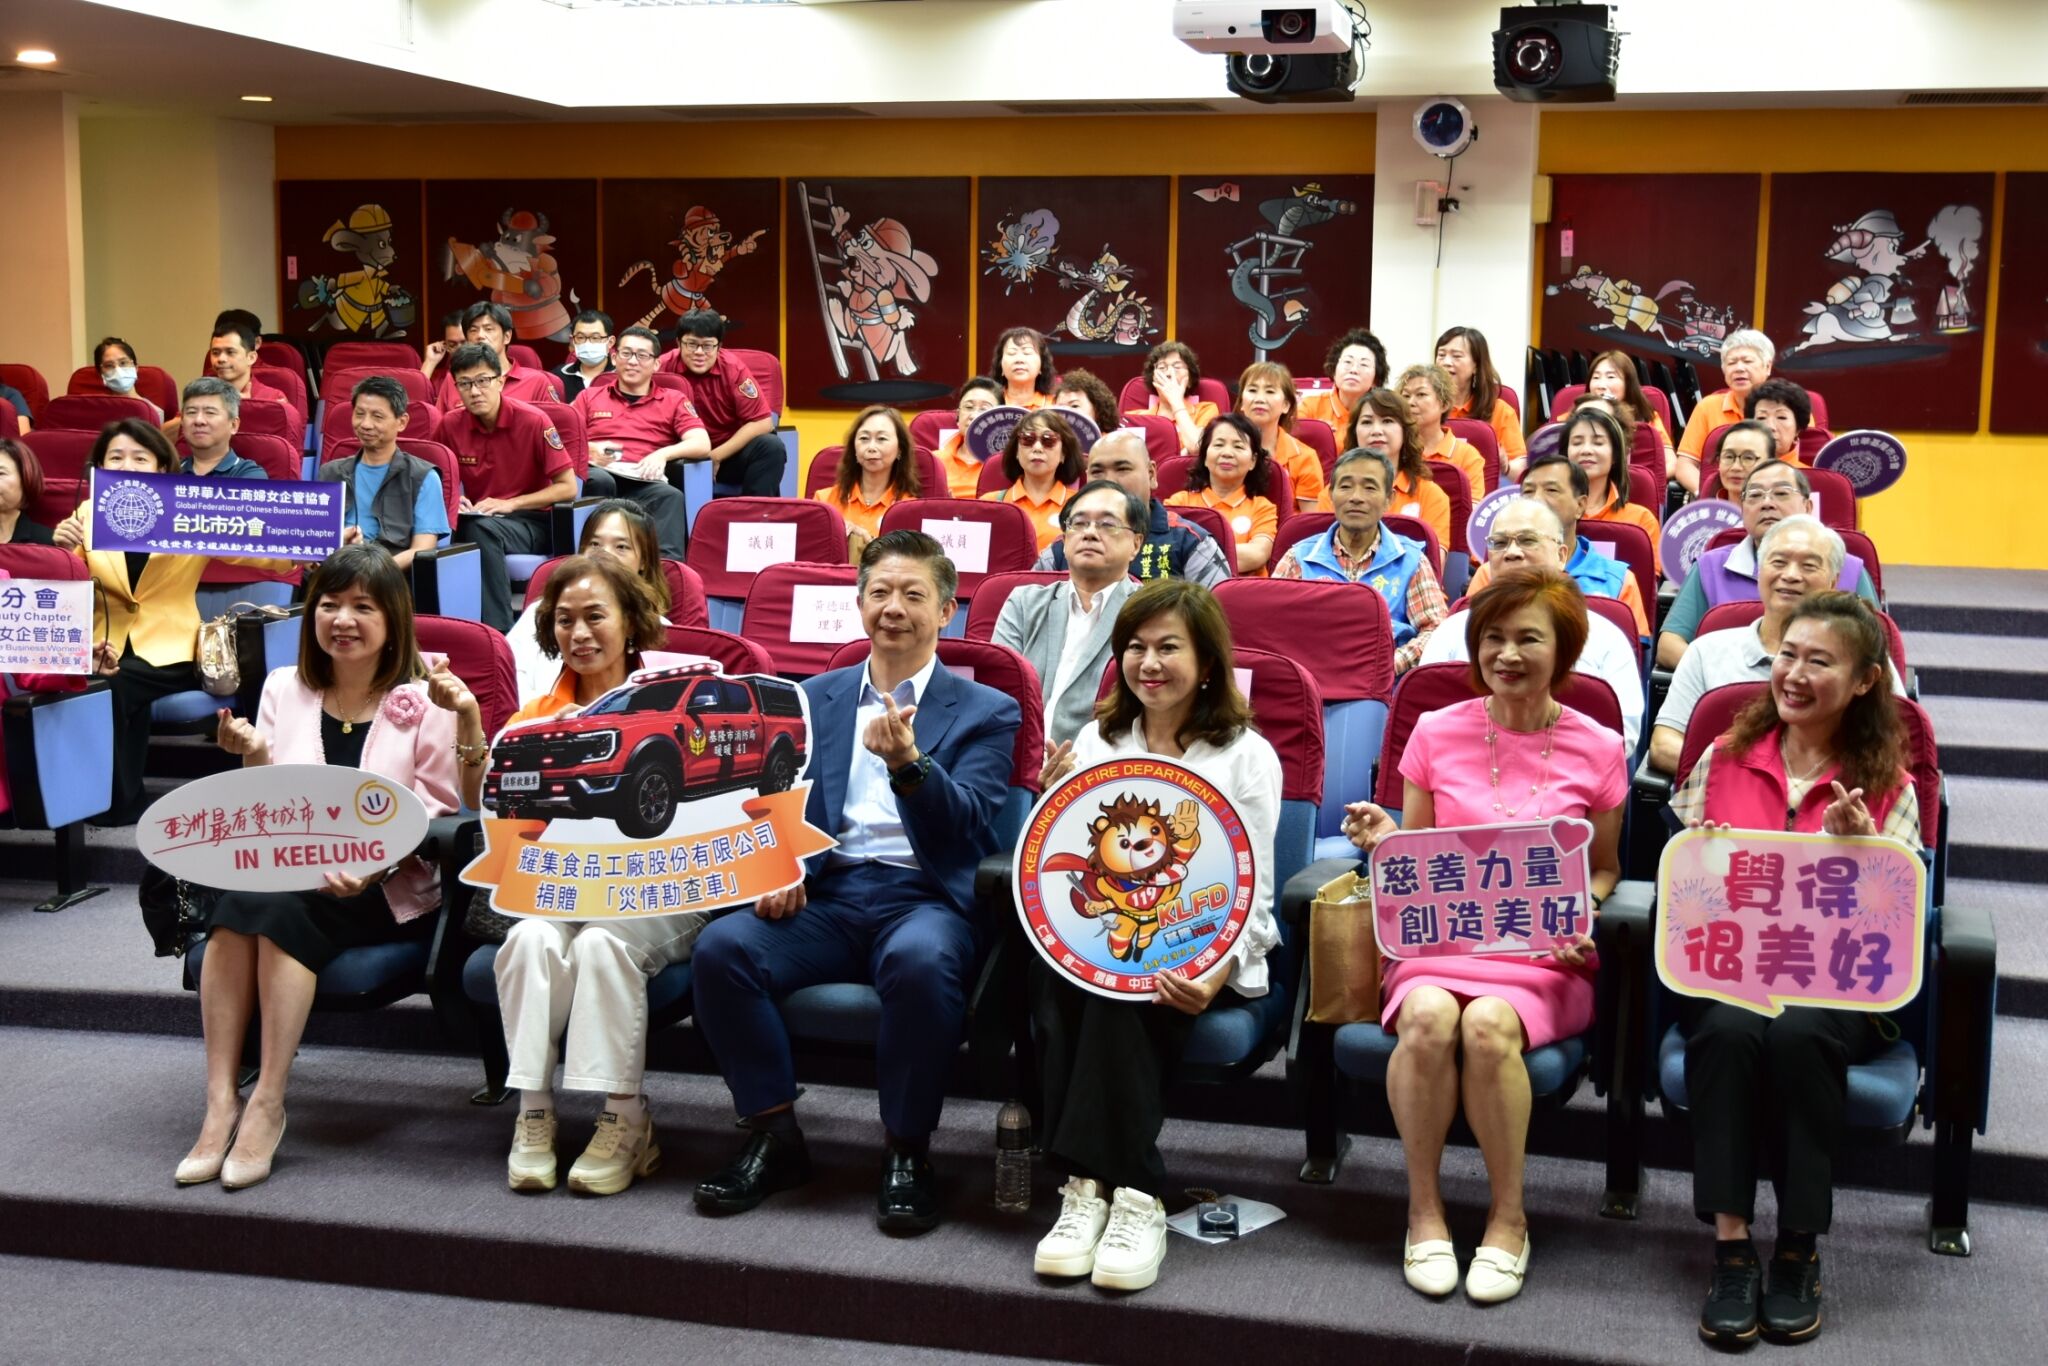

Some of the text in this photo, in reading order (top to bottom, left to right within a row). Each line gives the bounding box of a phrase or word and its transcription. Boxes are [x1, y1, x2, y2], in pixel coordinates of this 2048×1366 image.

[174, 484, 332, 506] 世界華人工商婦女企管協會
[175, 501, 330, 517] Global Federation of Chinese Business Women
[172, 512, 266, 537] 台北市分會
[266, 526, 336, 539] Taipei city chapter
[747, 536, 775, 551] 議員
[941, 533, 968, 549] 議員
[1, 587, 60, 609] 分會
[24, 611, 72, 623] Chapter
[818, 619, 843, 632] 理事
[0, 625, 82, 643] 女企管協會
[6, 643, 82, 653] Business Women
[709, 729, 756, 743] 基隆市消防局
[714, 743, 747, 757] 暖暖 41
[1025, 764, 1218, 873] KEELUNG CITY FIRE DEPARTMENT
[1219, 807, 1242, 837] 119
[235, 840, 386, 870] IN KEELUNG
[518, 822, 778, 880] 耀集食品工廠股份有限公司
[1379, 846, 1564, 895] 慈善力量
[536, 870, 740, 913] 捐贈 「災情勘查車」
[1723, 849, 1860, 917] 覺得
[1024, 881, 1038, 912] 119
[1130, 886, 1157, 907] 119
[1156, 883, 1229, 930] KLFD
[1398, 895, 1582, 947] 創造美好
[1683, 919, 1894, 995] 很美好
[1060, 953, 1088, 976] 信二
[1128, 975, 1154, 990] 中正
